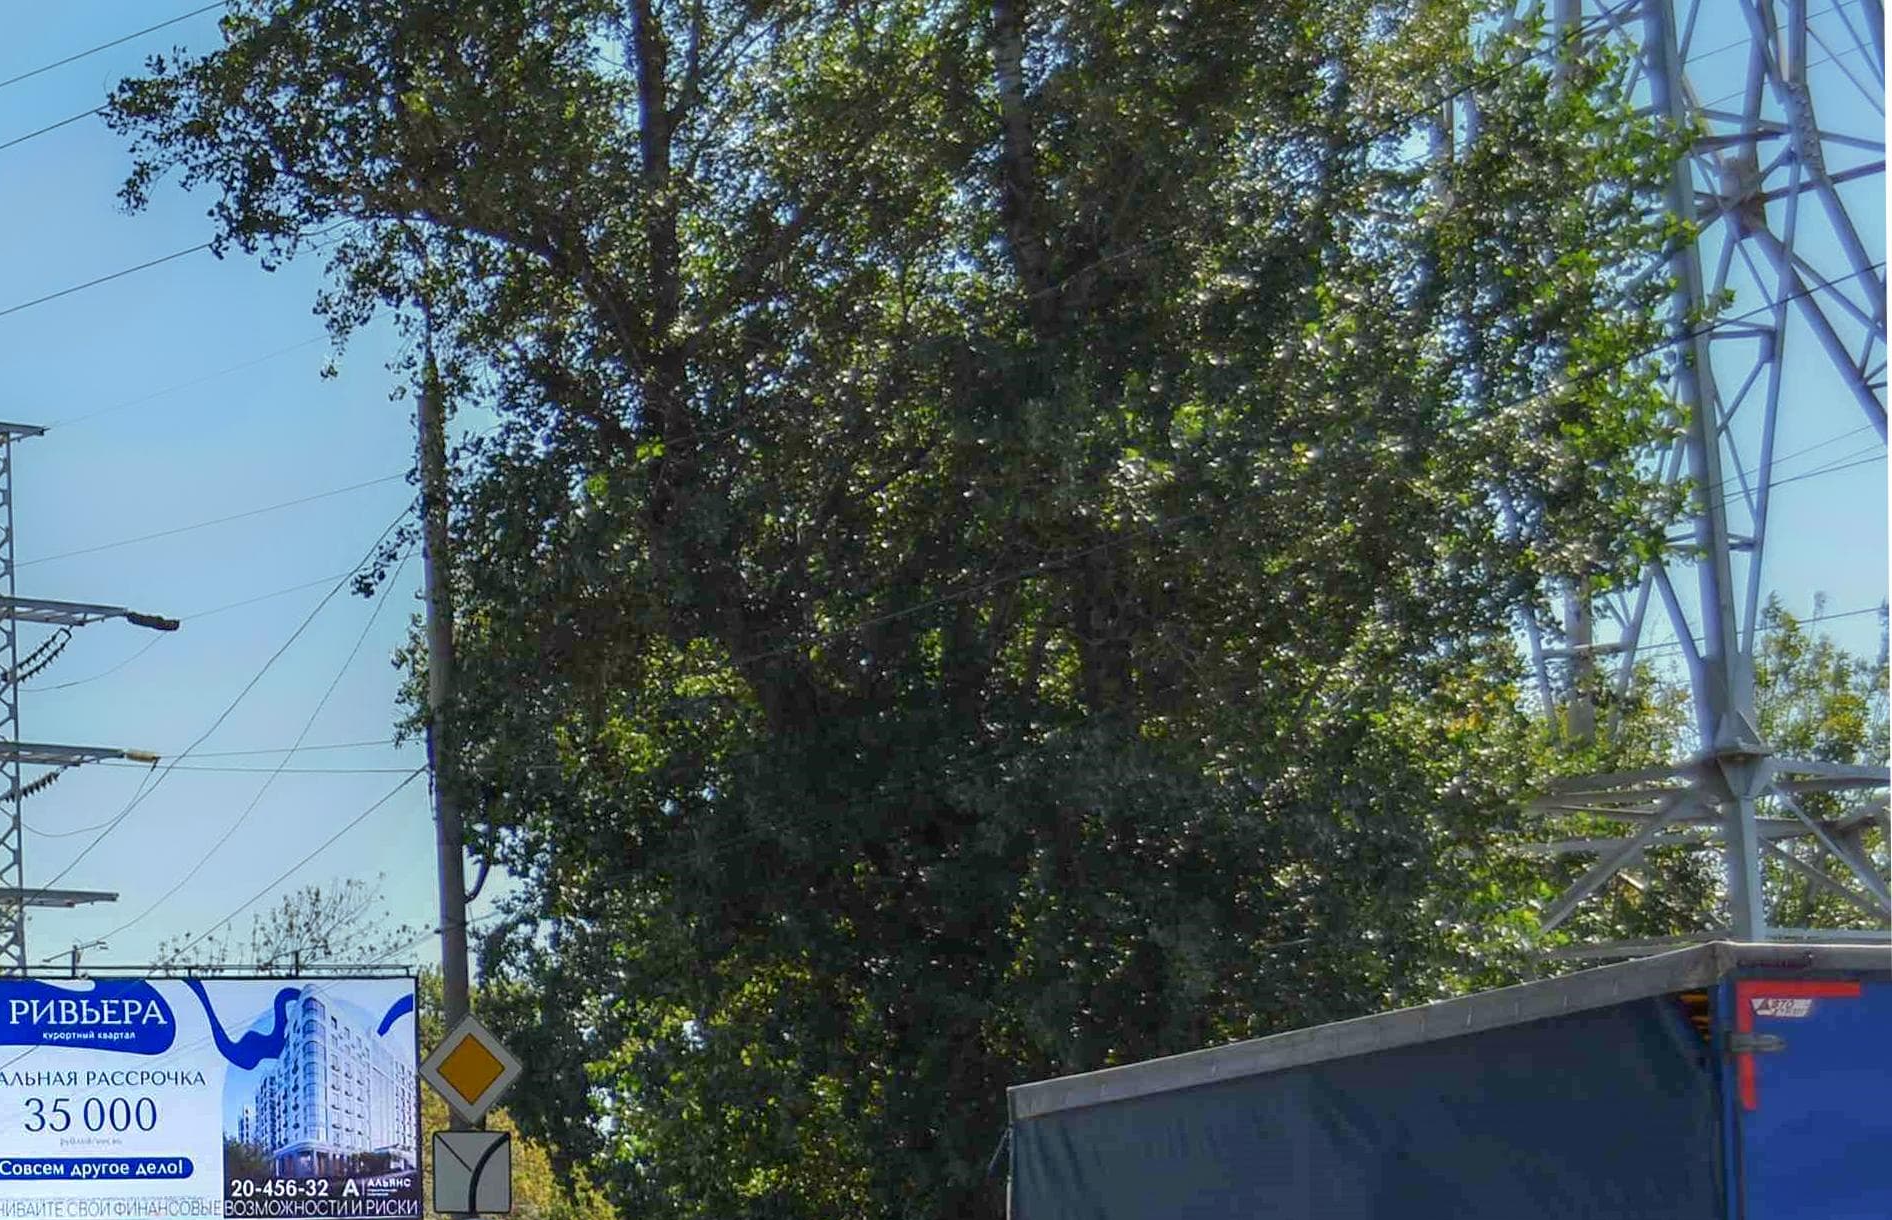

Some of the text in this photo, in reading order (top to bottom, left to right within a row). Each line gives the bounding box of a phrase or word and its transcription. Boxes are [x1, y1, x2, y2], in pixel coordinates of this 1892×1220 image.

[9, 999, 168, 1026] РИВЬЕРА
[42, 1030, 136, 1041] курортный квартал
[86, 1071, 206, 1087] РАССРОЧКА
[24, 1097, 158, 1132] 35 000
[70, 1160, 130, 1179] другое
[135, 1159, 184, 1176] дело!
[231, 1179, 329, 1198] 20-456-32
[367, 1178, 412, 1188] АЛЬЯНС
[224, 1200, 347, 1217] ВОЗМОЖНОСТИ
[351, 1200, 363, 1216] И
[366, 1199, 418, 1216] РИСКИ
